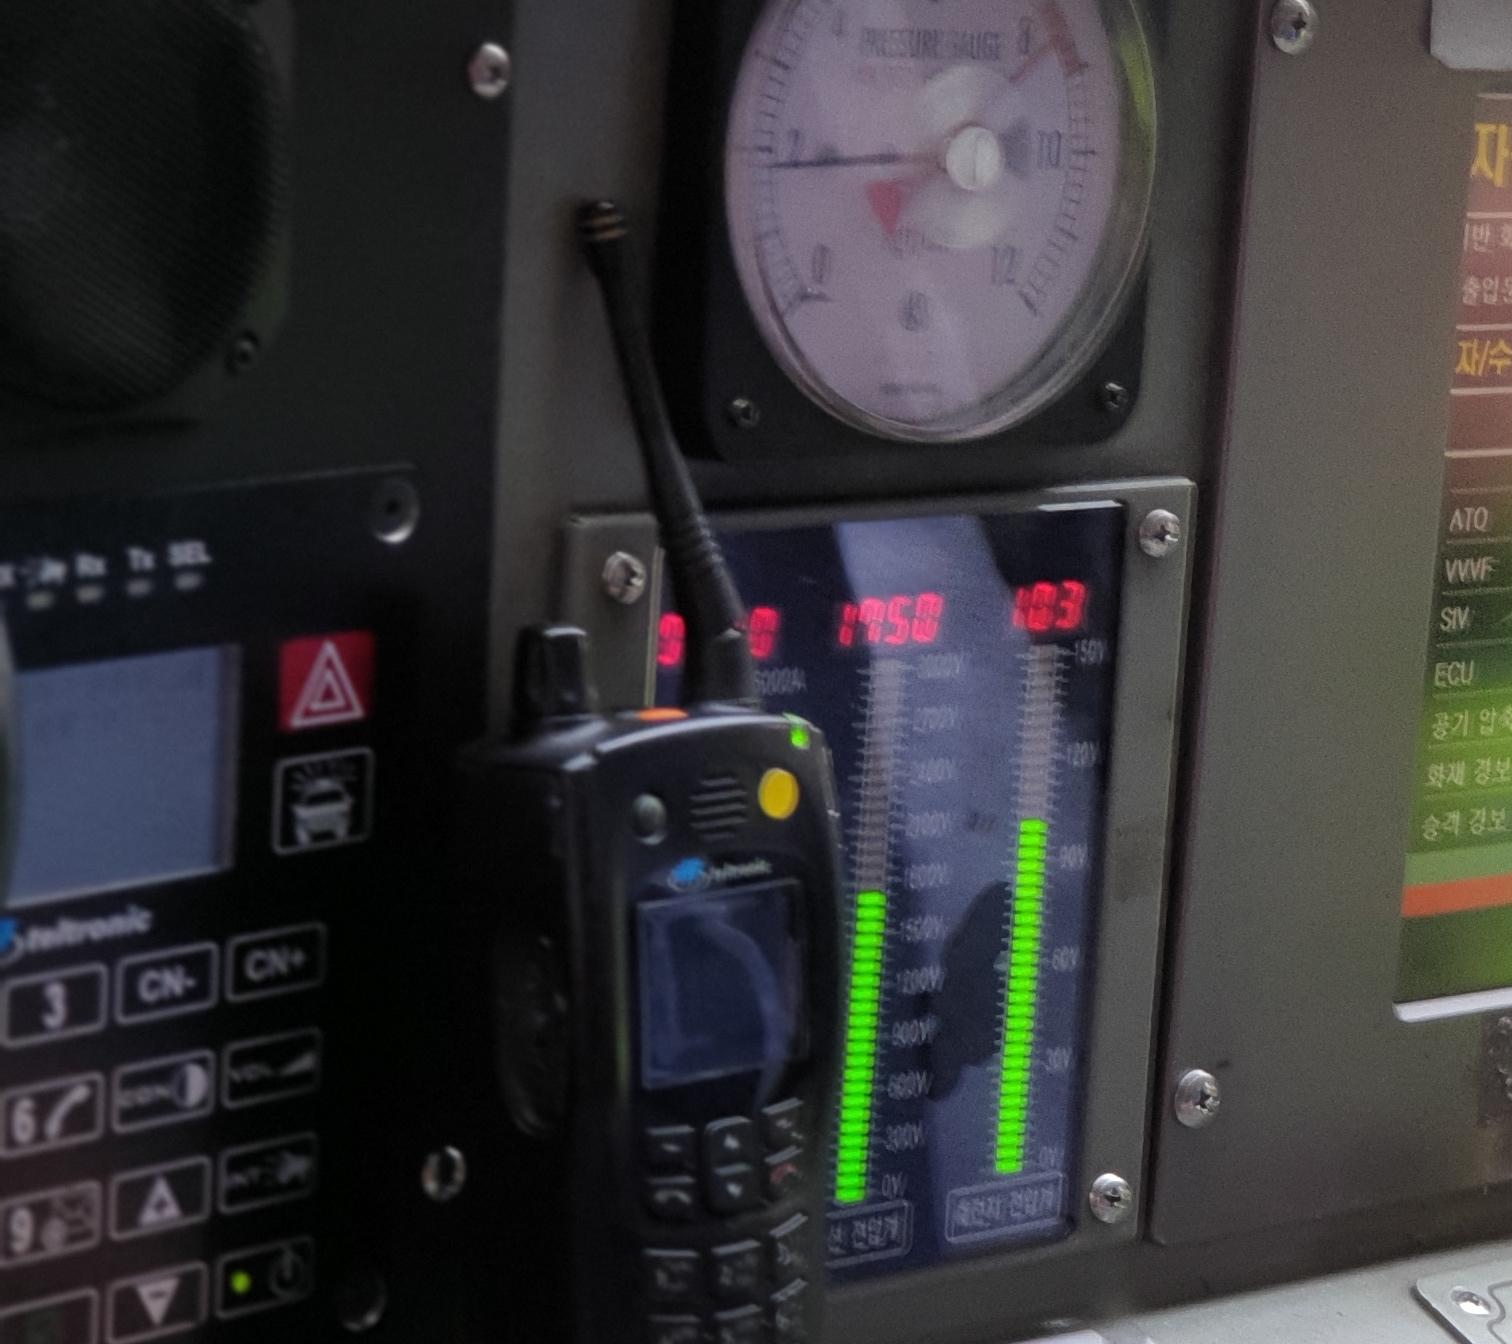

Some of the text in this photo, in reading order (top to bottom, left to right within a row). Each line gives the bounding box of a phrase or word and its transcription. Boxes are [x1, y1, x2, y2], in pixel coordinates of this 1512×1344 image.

[1446, 557, 1494, 584] VVVF
[1013, 579, 1086, 632] 103
[1440, 608, 1470, 632] SIV
[1434, 662, 1474, 688] ECU
[1432, 711, 1470, 740] 공기
[245, 949, 306, 982] CN+
[139, 966, 196, 1002] CN-
[42, 982, 67, 1028] 3
[12, 1098, 36, 1145] 6
[10, 1208, 33, 1253] 9
